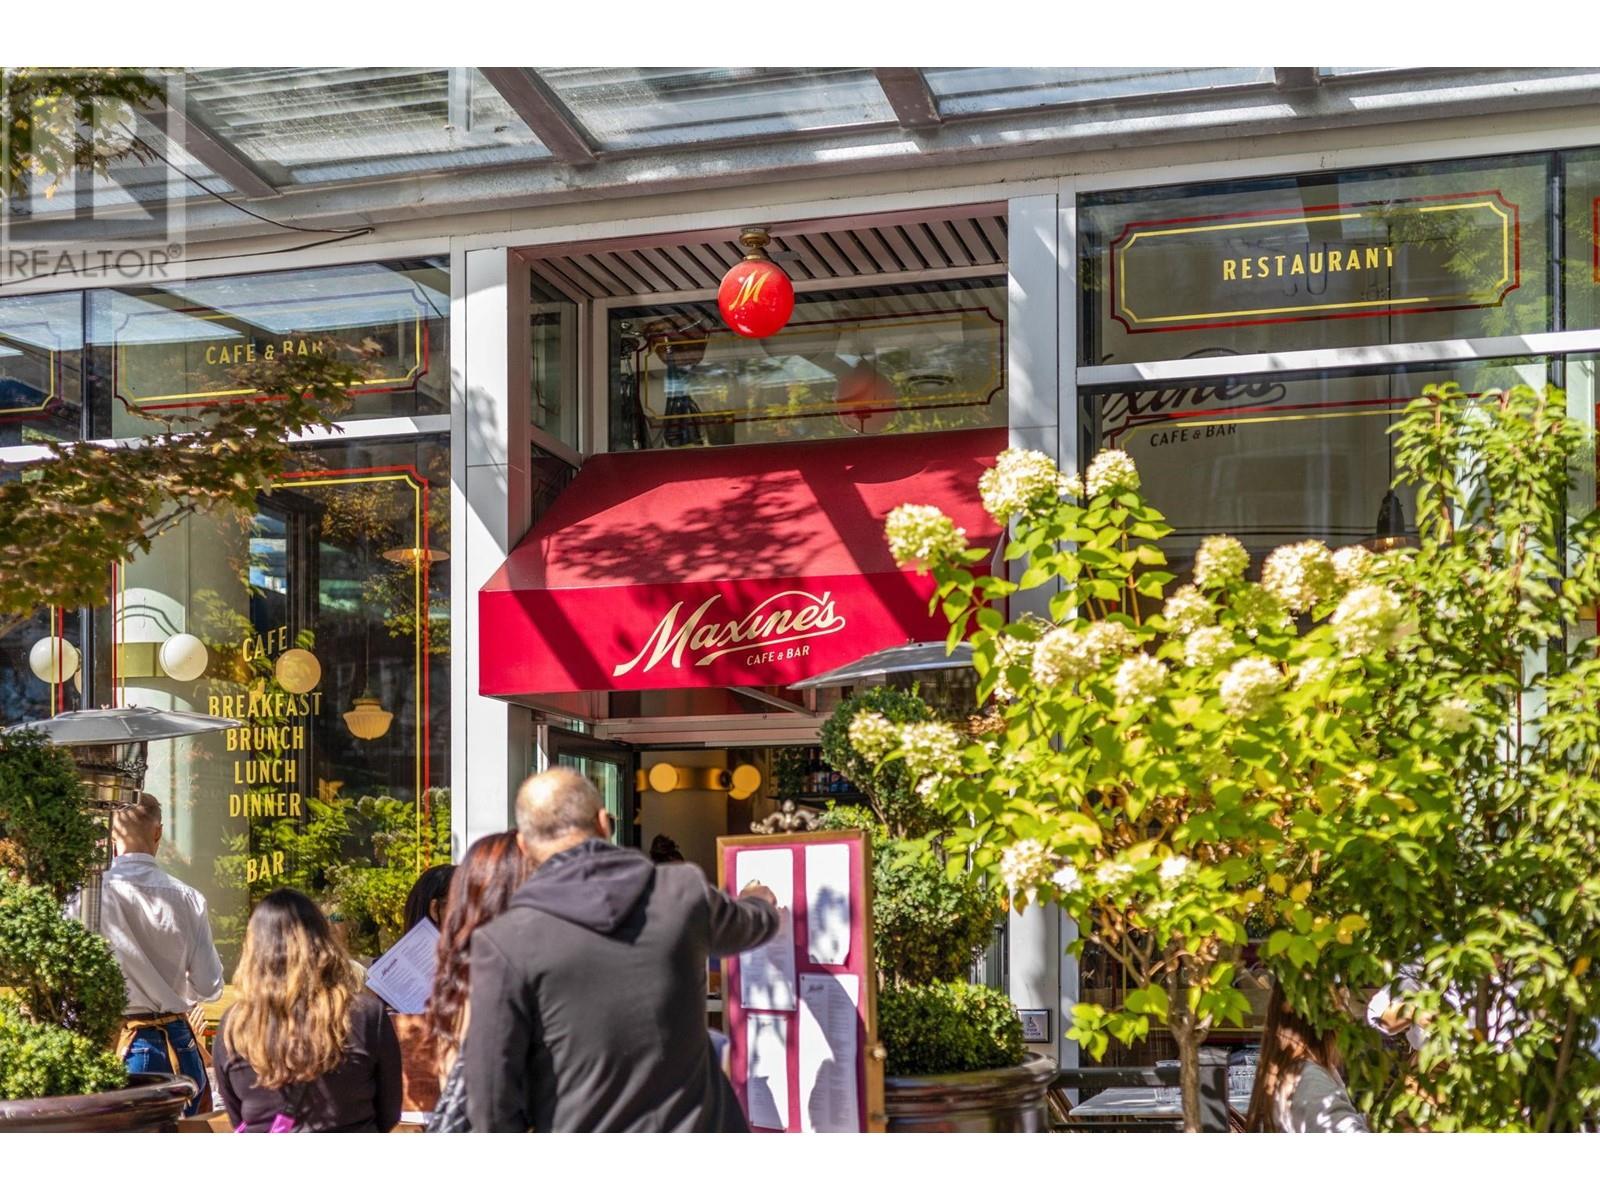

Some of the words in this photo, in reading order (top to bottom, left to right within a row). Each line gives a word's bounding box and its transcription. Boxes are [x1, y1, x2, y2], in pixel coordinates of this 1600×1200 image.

[1223, 247, 1393, 281] RESTAURANT
[729, 269, 774, 311] M
[205, 343, 256, 365] CAFE
[264, 344, 274, 361] &
[1150, 428, 1189, 447] CAFE
[1192, 429, 1202, 440] &
[1206, 423, 1238, 438] BAR
[242, 625, 288, 662] CAFE
[612, 590, 846, 677] Maxine's
[746, 651, 775, 666] CAFE
[777, 651, 784, 661] &
[786, 645, 810, 659] BAR
[208, 692, 323, 718] BREAKFAST
[226, 726, 304, 752] BRUNCH
[234, 759, 296, 785] LUNCH
[229, 792, 302, 818] DINNER
[246, 850, 285, 884] BAR
